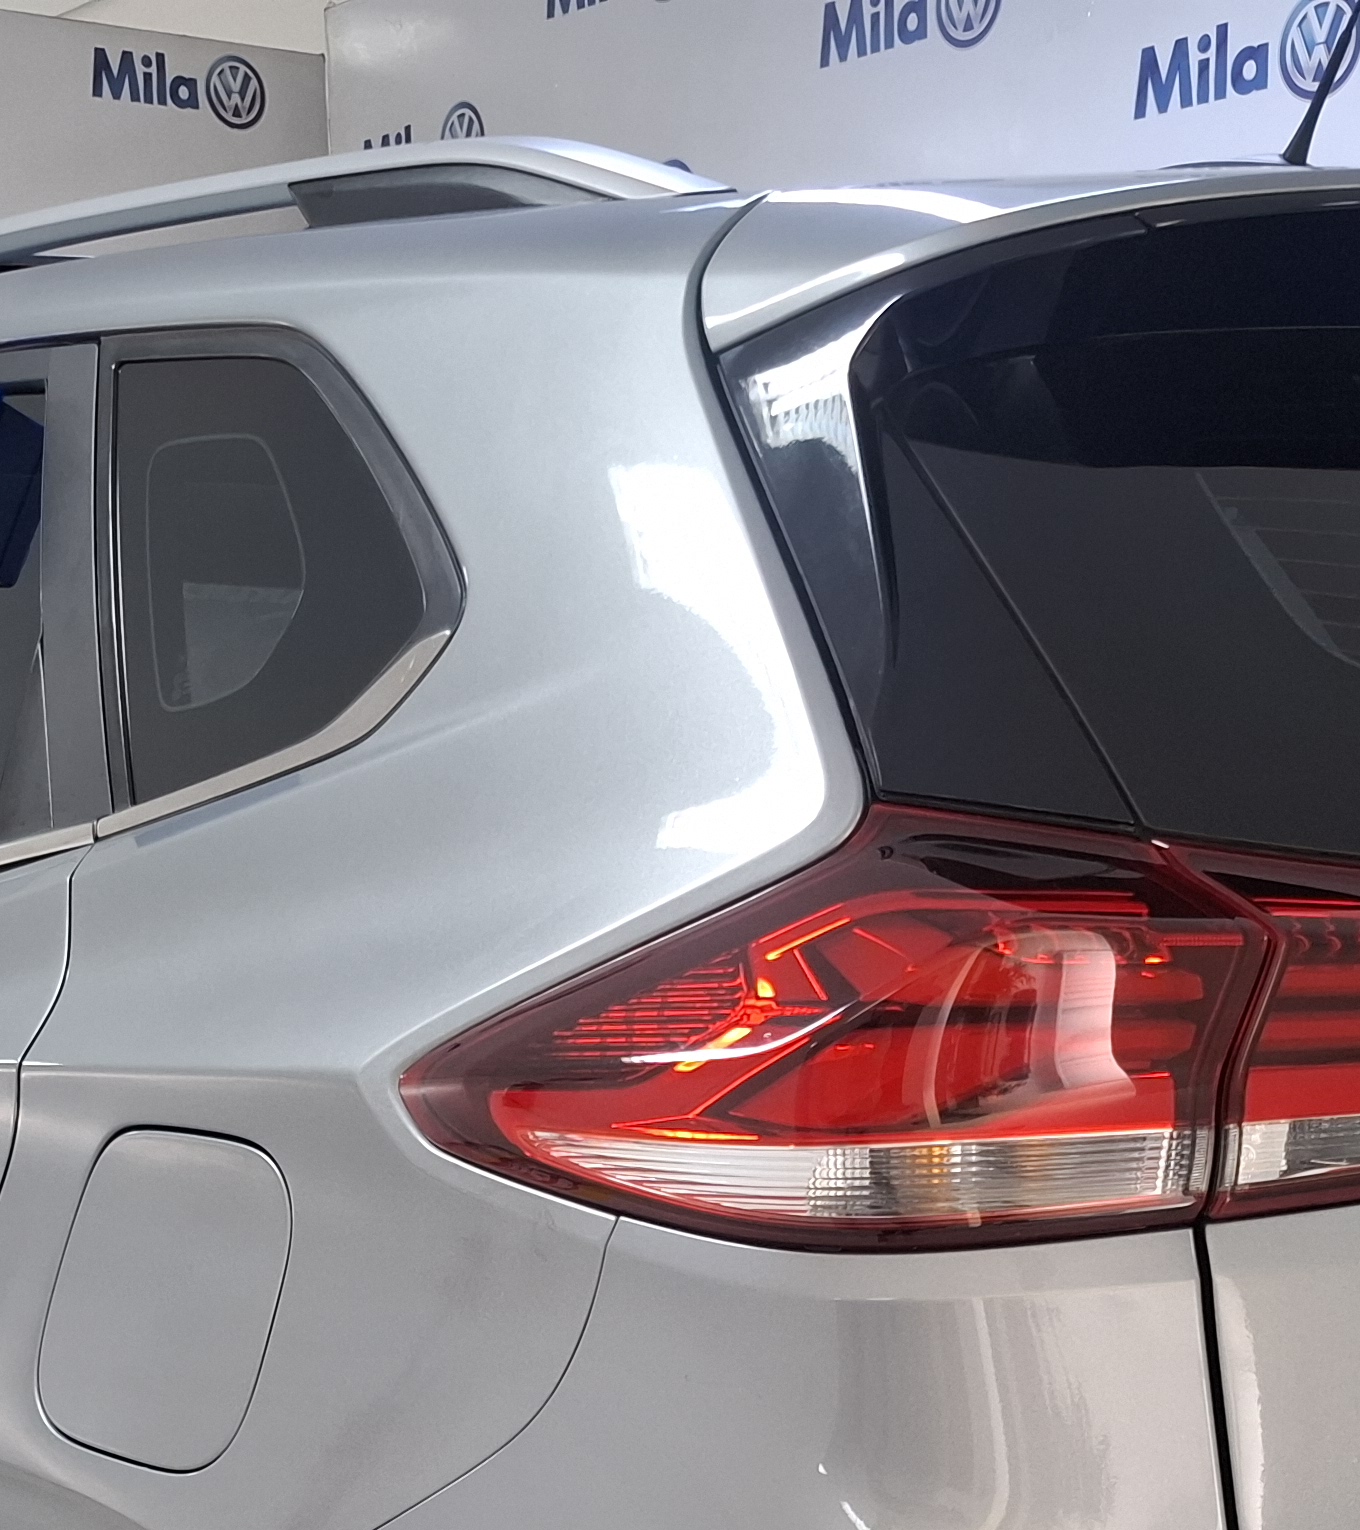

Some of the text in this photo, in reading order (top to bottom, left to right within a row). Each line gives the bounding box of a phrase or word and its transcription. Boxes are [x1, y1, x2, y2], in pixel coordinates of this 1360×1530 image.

[820, 0, 928, 68] Mila
[91, 48, 200, 110] Mila
[1134, 22, 1269, 120] Mila
